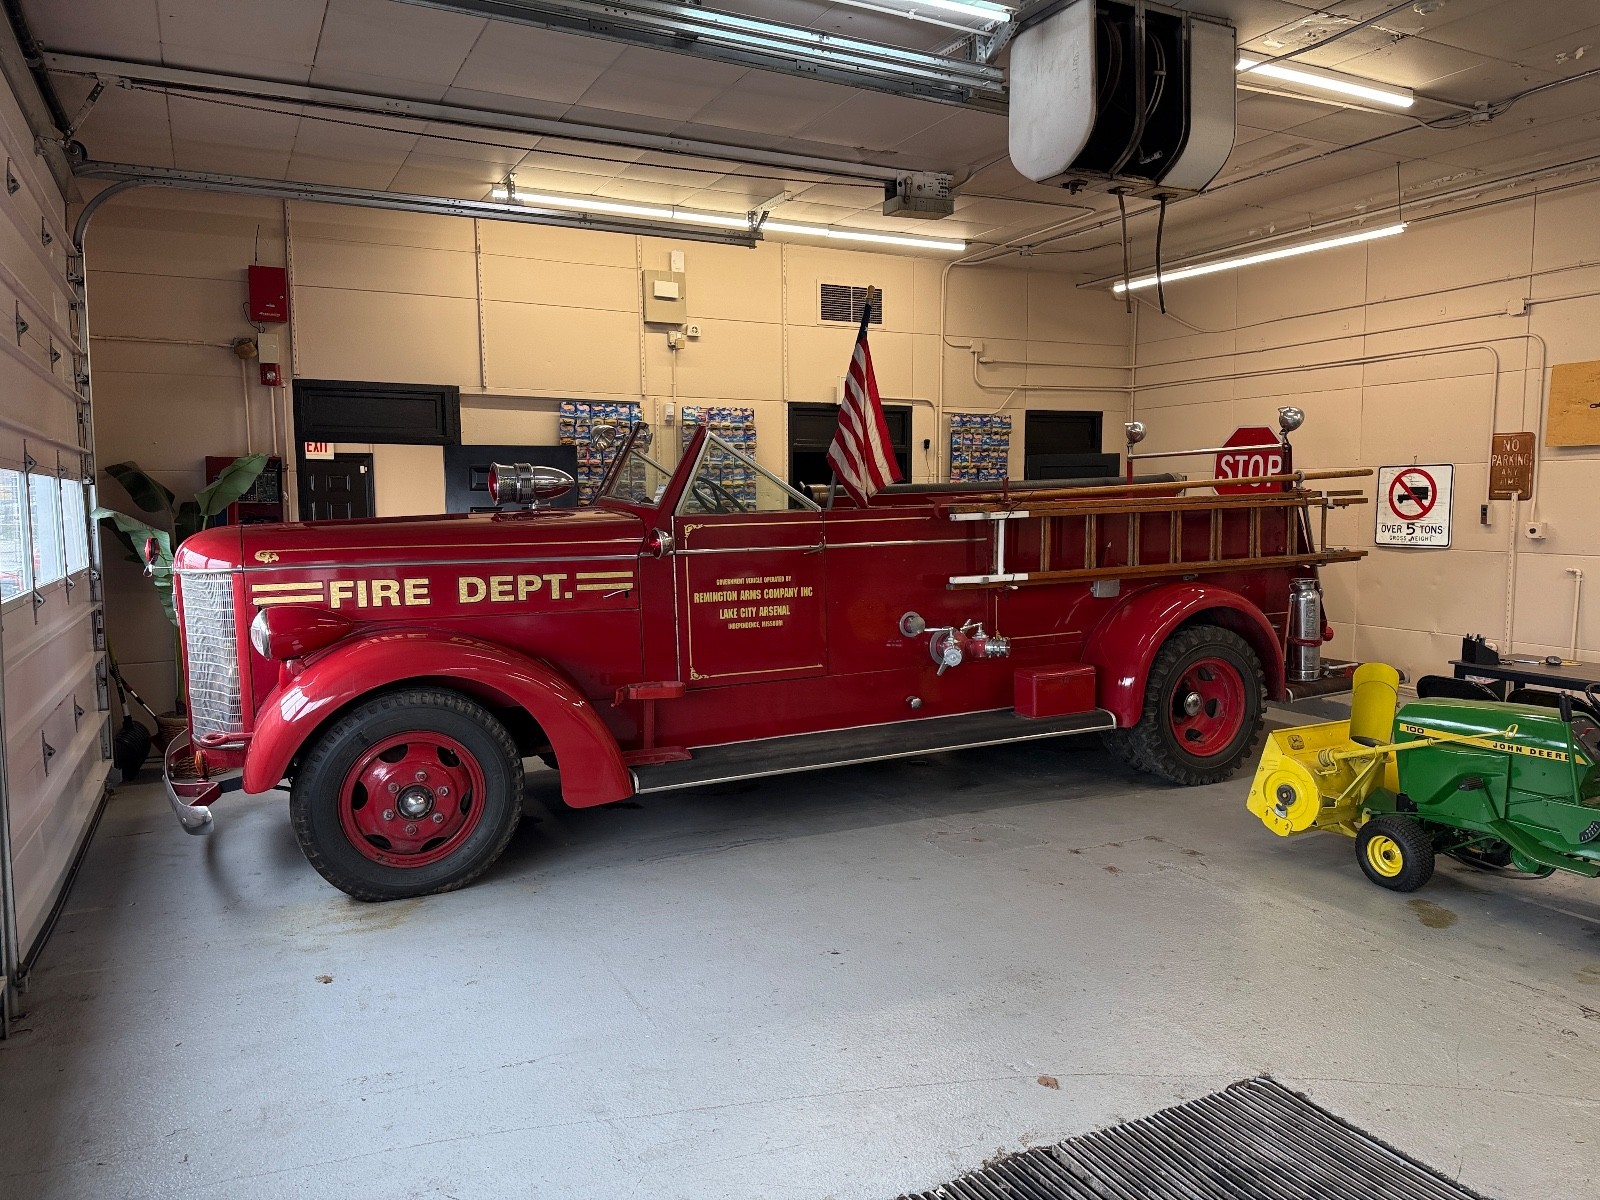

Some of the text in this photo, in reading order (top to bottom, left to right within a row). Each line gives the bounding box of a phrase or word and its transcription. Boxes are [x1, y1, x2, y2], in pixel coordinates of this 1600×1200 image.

[1502, 439, 1520, 451] NO
[1491, 453, 1530, 467] PARKING
[1220, 454, 1283, 487] STOP
[1501, 468, 1519, 476] ANY
[1500, 477, 1520, 486] TIME
[1381, 522, 1443, 536] OVER 5 TONS
[716, 577, 745, 585] GOVERNMENT
[745, 576, 762, 584] VEHICLE
[764, 575, 784, 583] OPERATED
[329, 573, 573, 609] FIRE DEPT.
[693, 586, 813, 603] REMINGTON ARMS COMPANY INC
[719, 604, 791, 620] LAKE CITY ARSENAL
[1405, 725, 1425, 735] 100
[1492, 742, 1570, 761] JOHN DEERE
